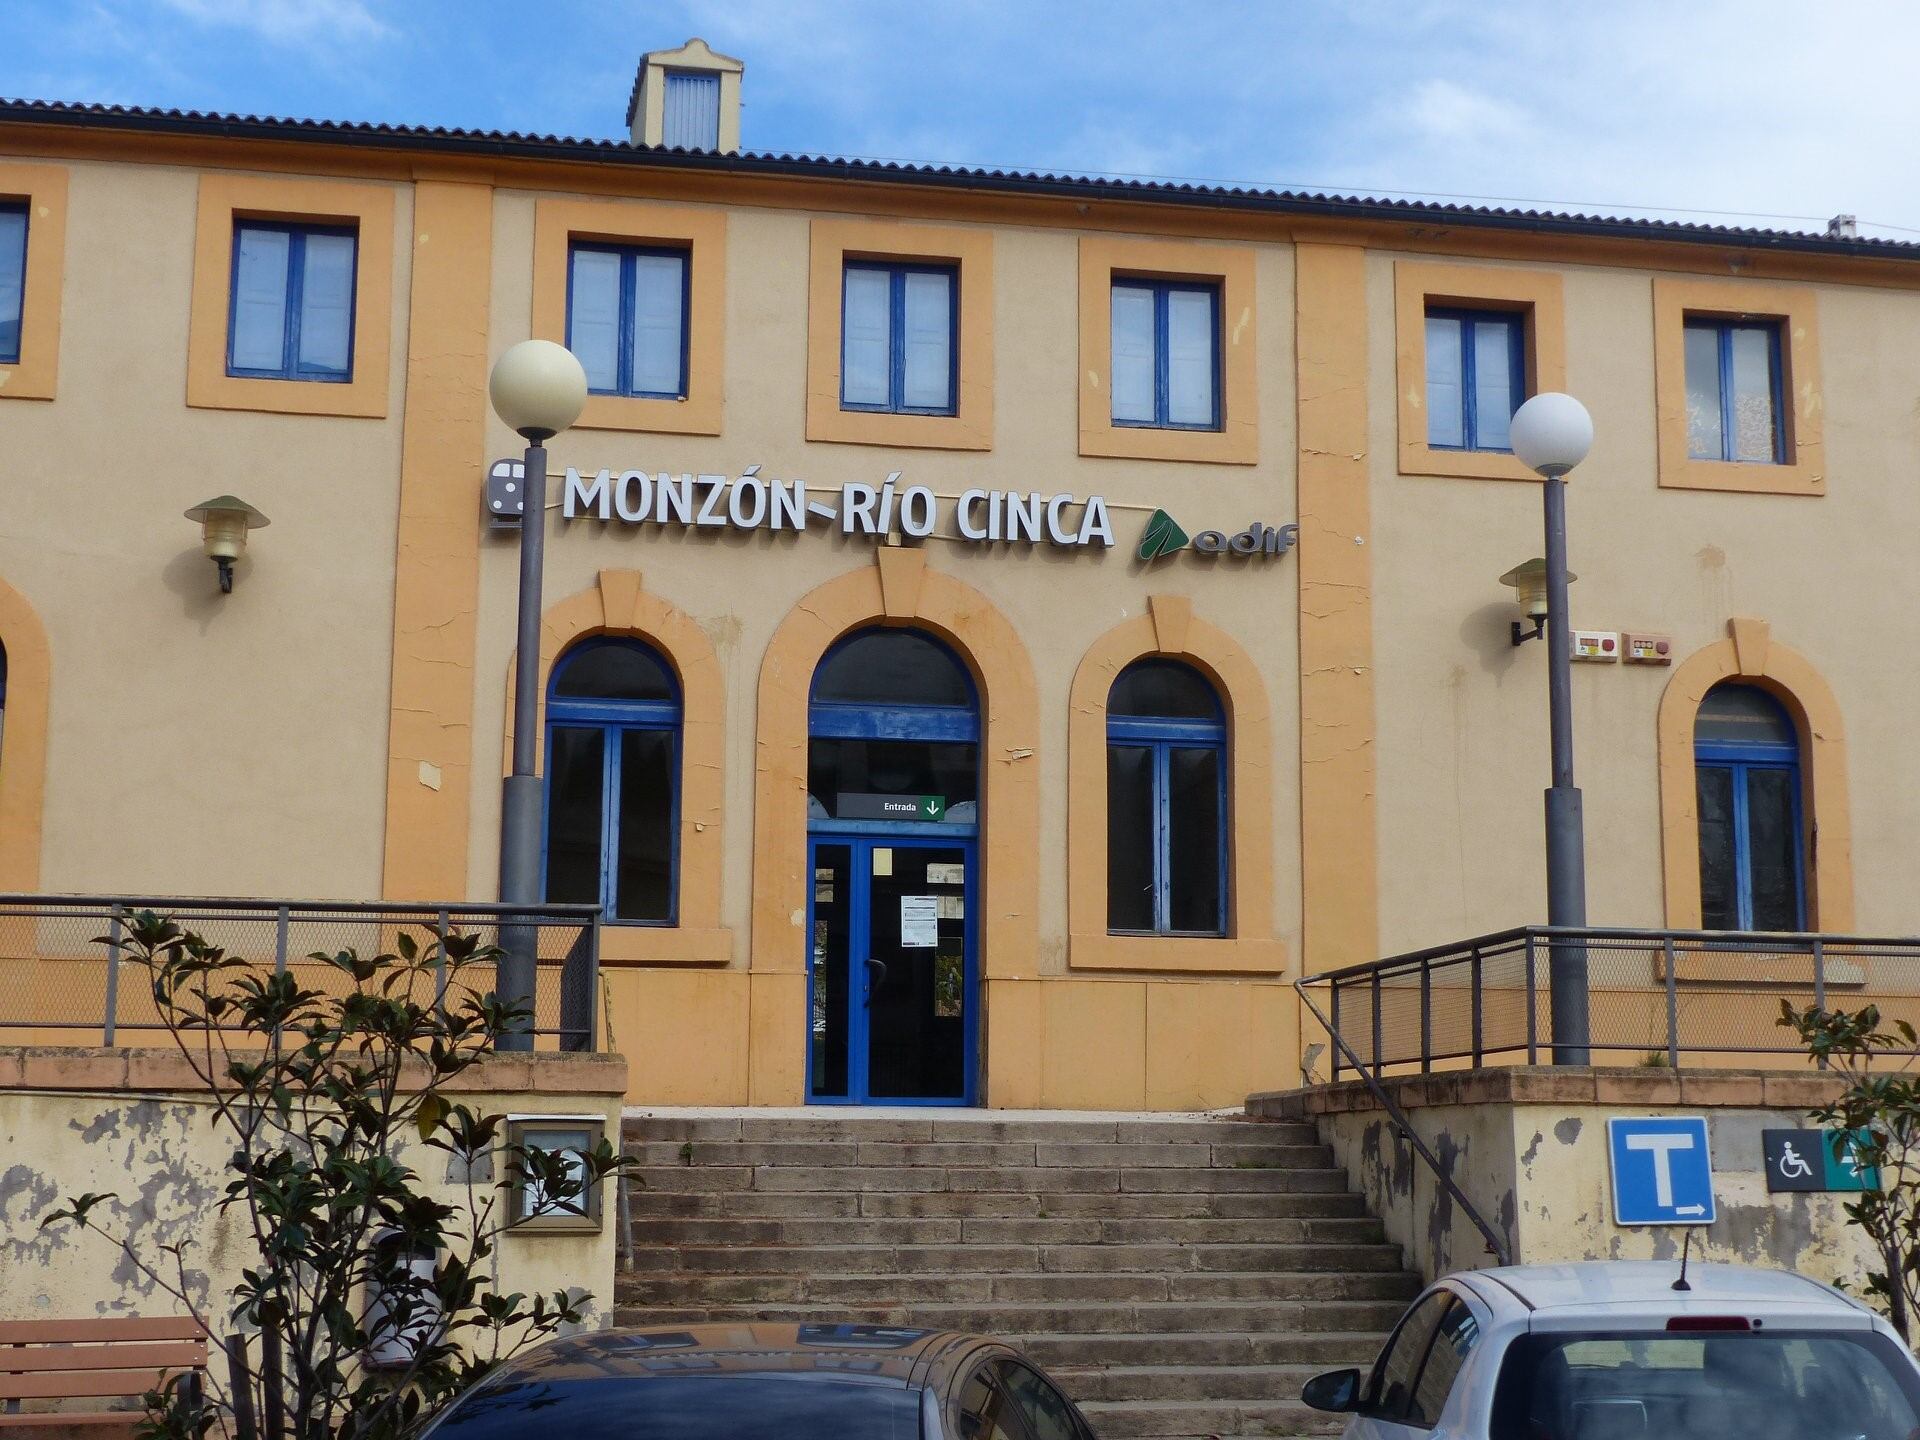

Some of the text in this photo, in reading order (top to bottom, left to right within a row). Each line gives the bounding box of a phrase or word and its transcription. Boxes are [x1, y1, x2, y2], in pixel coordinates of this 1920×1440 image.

[956, 487, 1116, 547] CINCA
[1193, 521, 1299, 554] adif
[884, 802, 917, 812] Entrada
[1625, 1133, 1694, 1207] T
